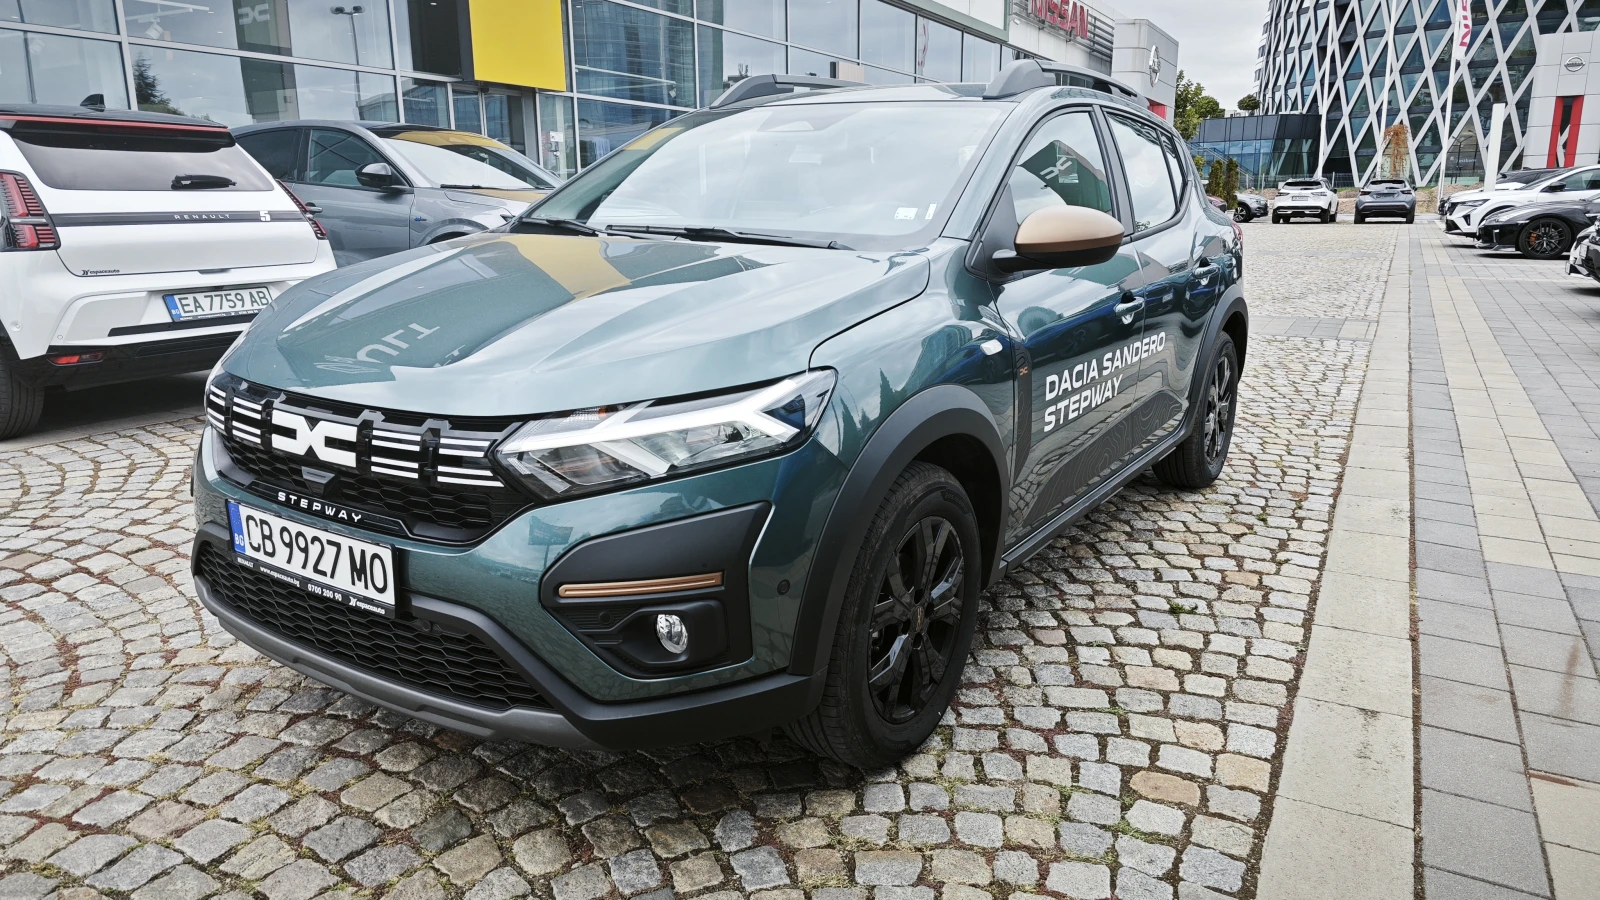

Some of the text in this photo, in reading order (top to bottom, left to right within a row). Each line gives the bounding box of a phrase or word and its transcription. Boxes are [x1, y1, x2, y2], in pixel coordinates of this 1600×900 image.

[259, 210, 271, 222] 5
[178, 290, 270, 314] EA 7759 AB
[1045, 331, 1166, 401] DACIA SANDERO
[1044, 373, 1123, 432] STEPWAY
[277, 491, 362, 523] STEPWAY
[234, 533, 245, 546] BG
[245, 514, 388, 594] CB 9927 MO
[307, 583, 342, 601] 0700 200 90
